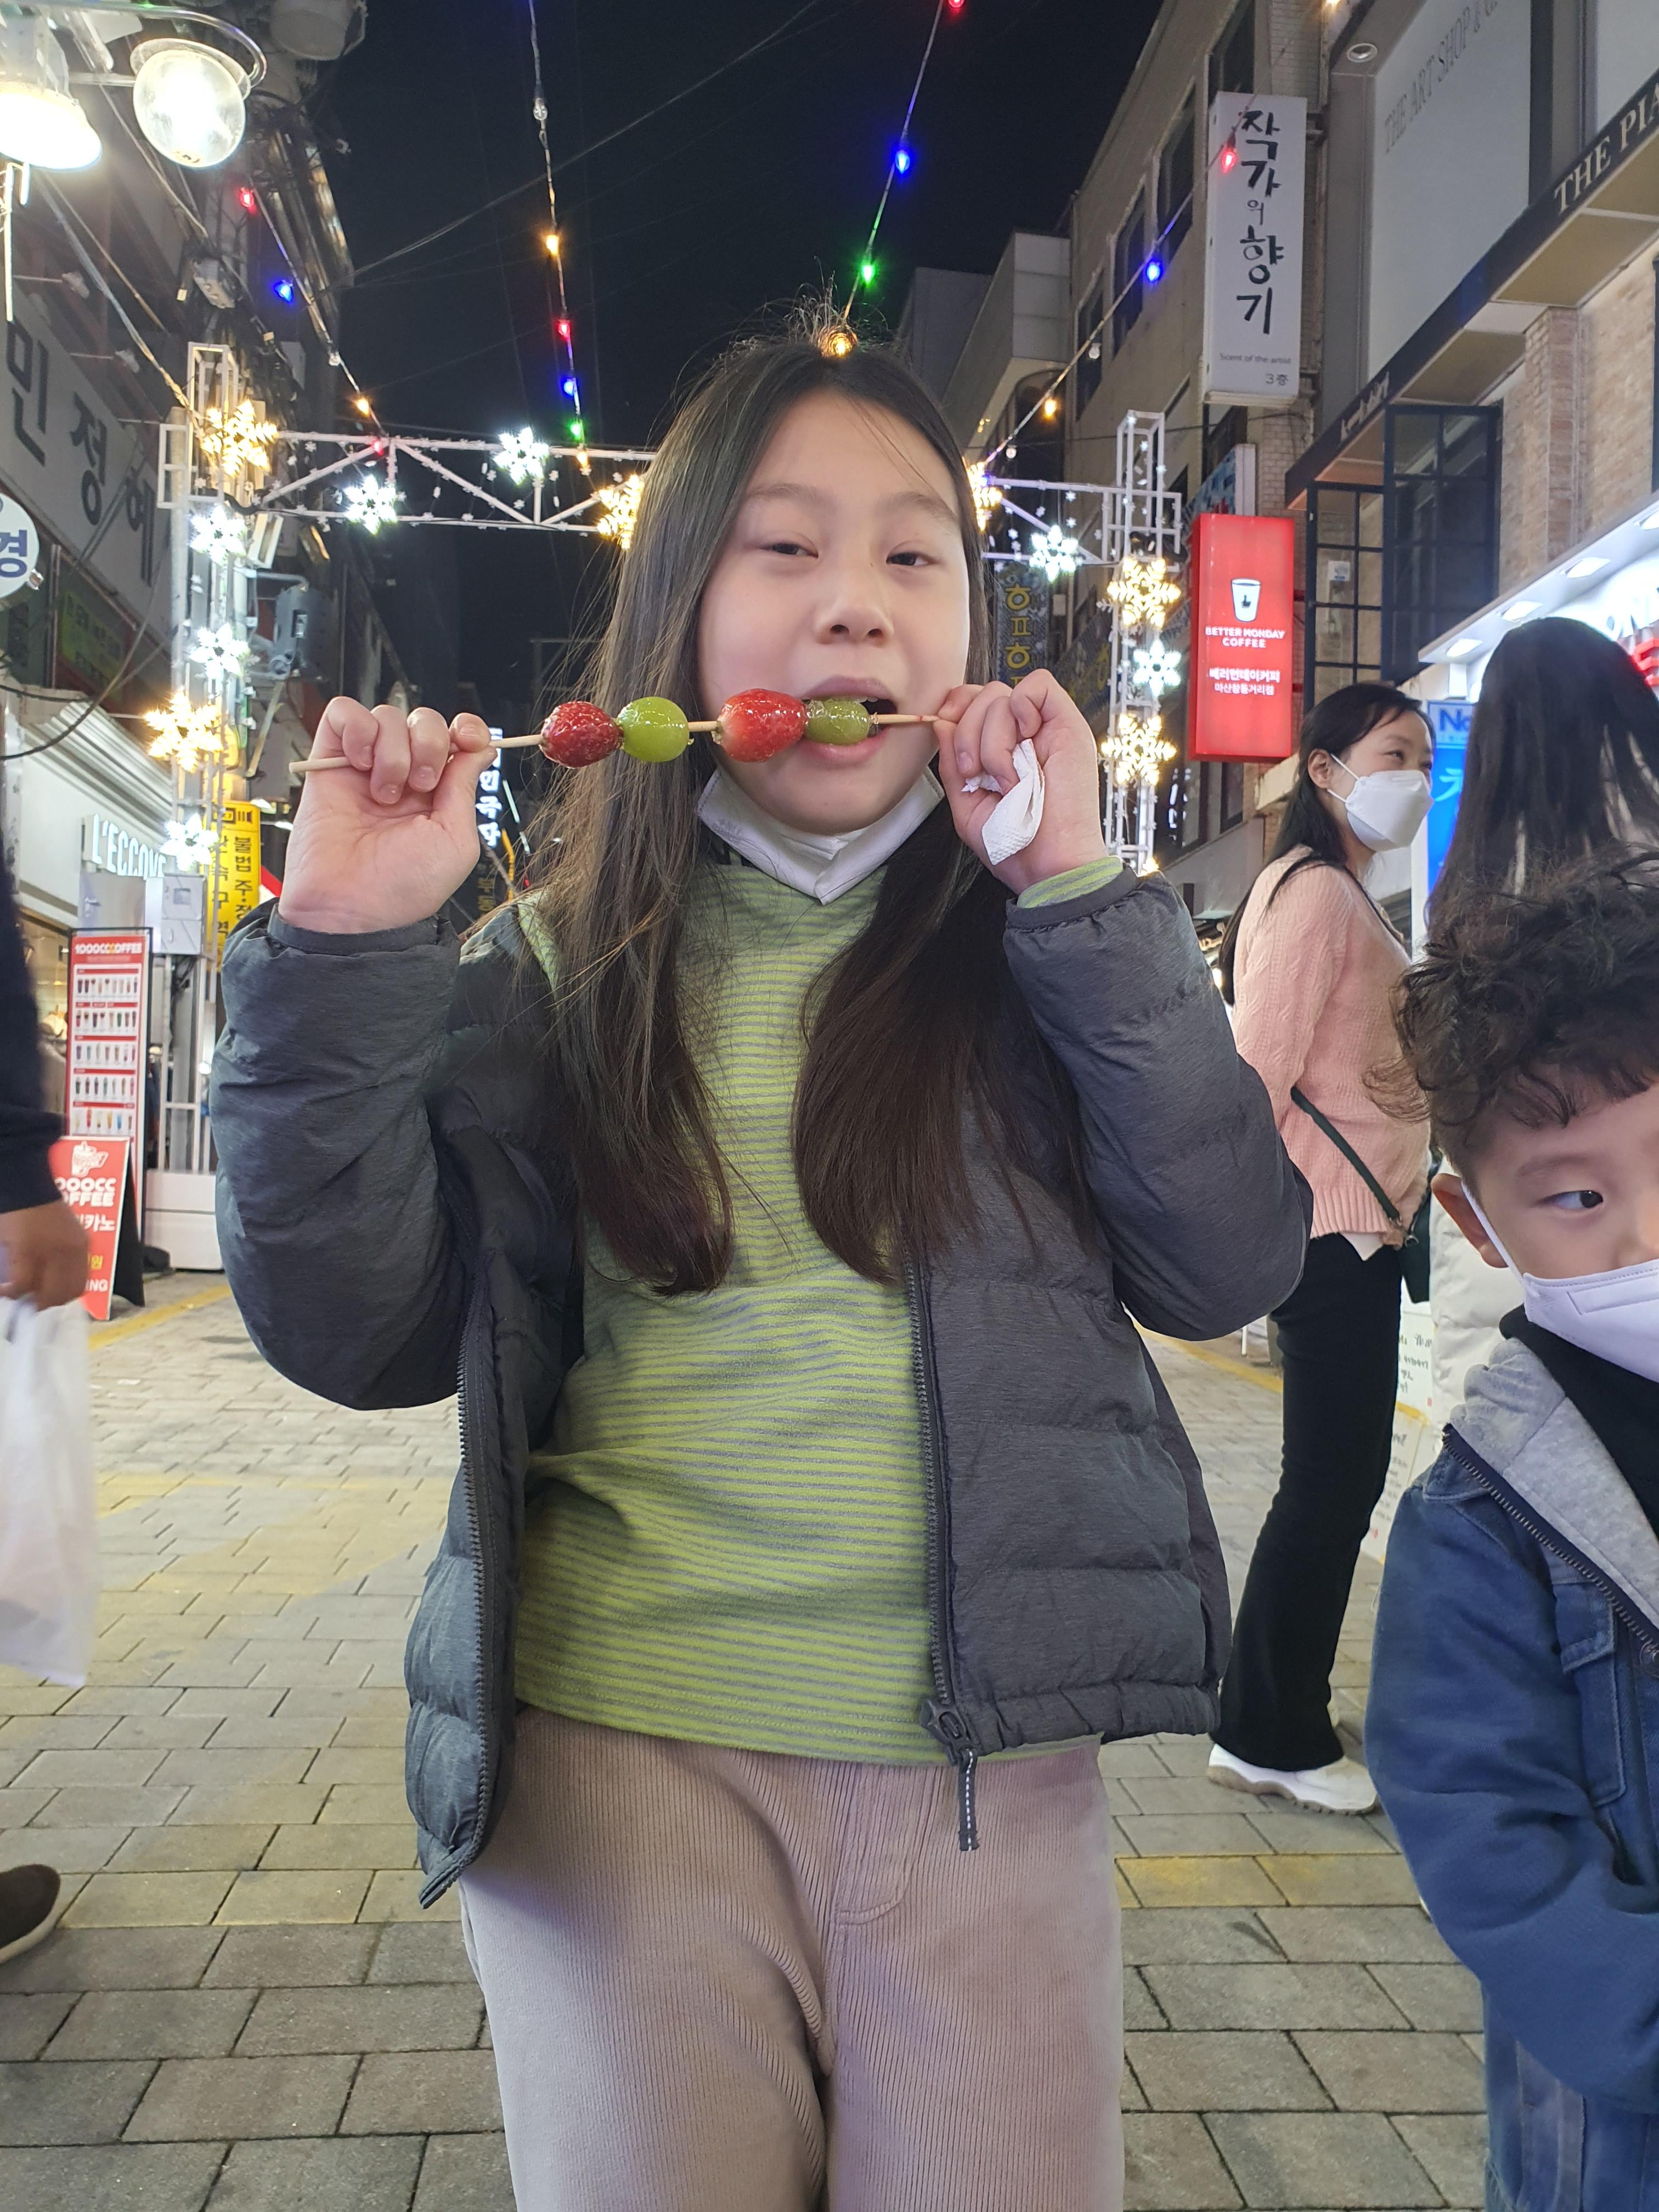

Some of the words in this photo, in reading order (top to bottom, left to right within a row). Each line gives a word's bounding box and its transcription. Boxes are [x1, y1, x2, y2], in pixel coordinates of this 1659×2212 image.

[1385, 93, 1407, 154] THE
[1410, 54, 1435, 122] ART
[1554, 136, 1611, 217] THE
[1236, 225, 1284, 335] 향기
[1265, 373, 1289, 386] 3층
[1205, 627, 1242, 637] BETTER
[1243, 628, 1286, 639] MONDAY
[1222, 637, 1267, 648] COFFEE
[234, 836, 252, 872] 불법
[54, 1177, 117, 1192] 000CC
[63, 1190, 115, 1207] FFEE
[80, 1213, 115, 1232] 카노
